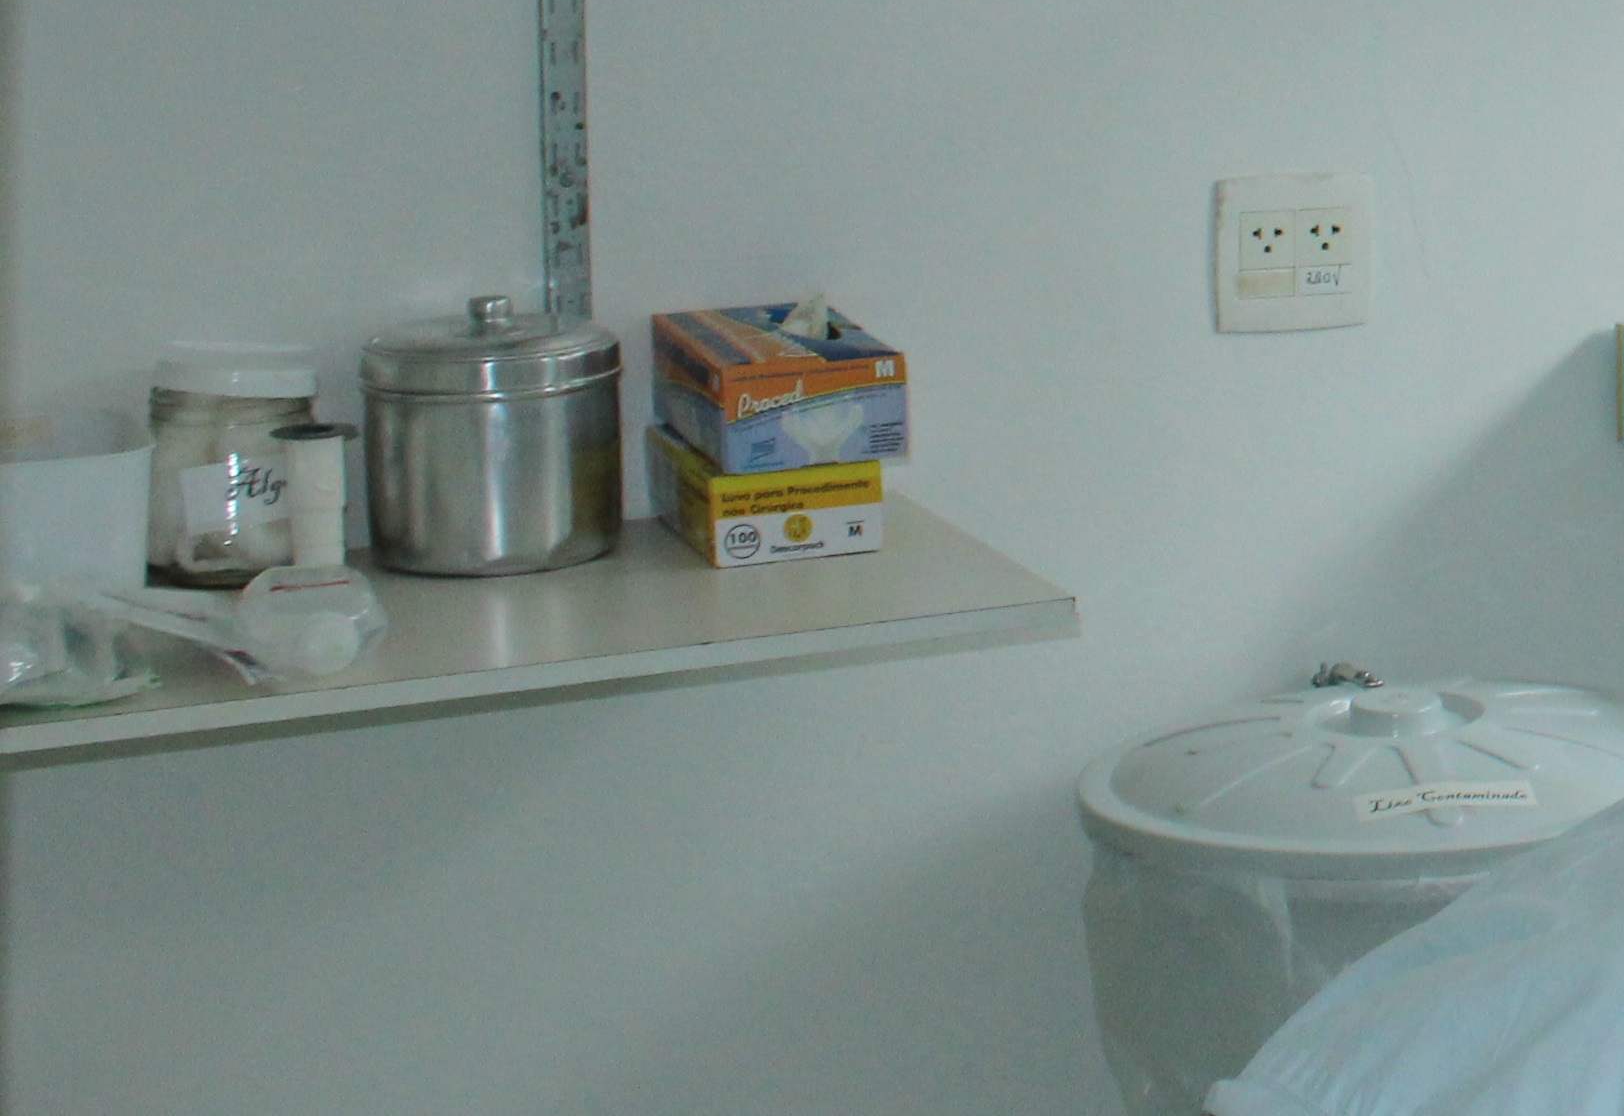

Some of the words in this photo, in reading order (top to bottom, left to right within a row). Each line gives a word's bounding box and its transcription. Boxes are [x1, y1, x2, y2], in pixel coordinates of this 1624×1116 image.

[875, 359, 896, 378] M
[737, 378, 805, 418] Proced
[754, 489, 783, 502] para
[730, 530, 757, 545] 100
